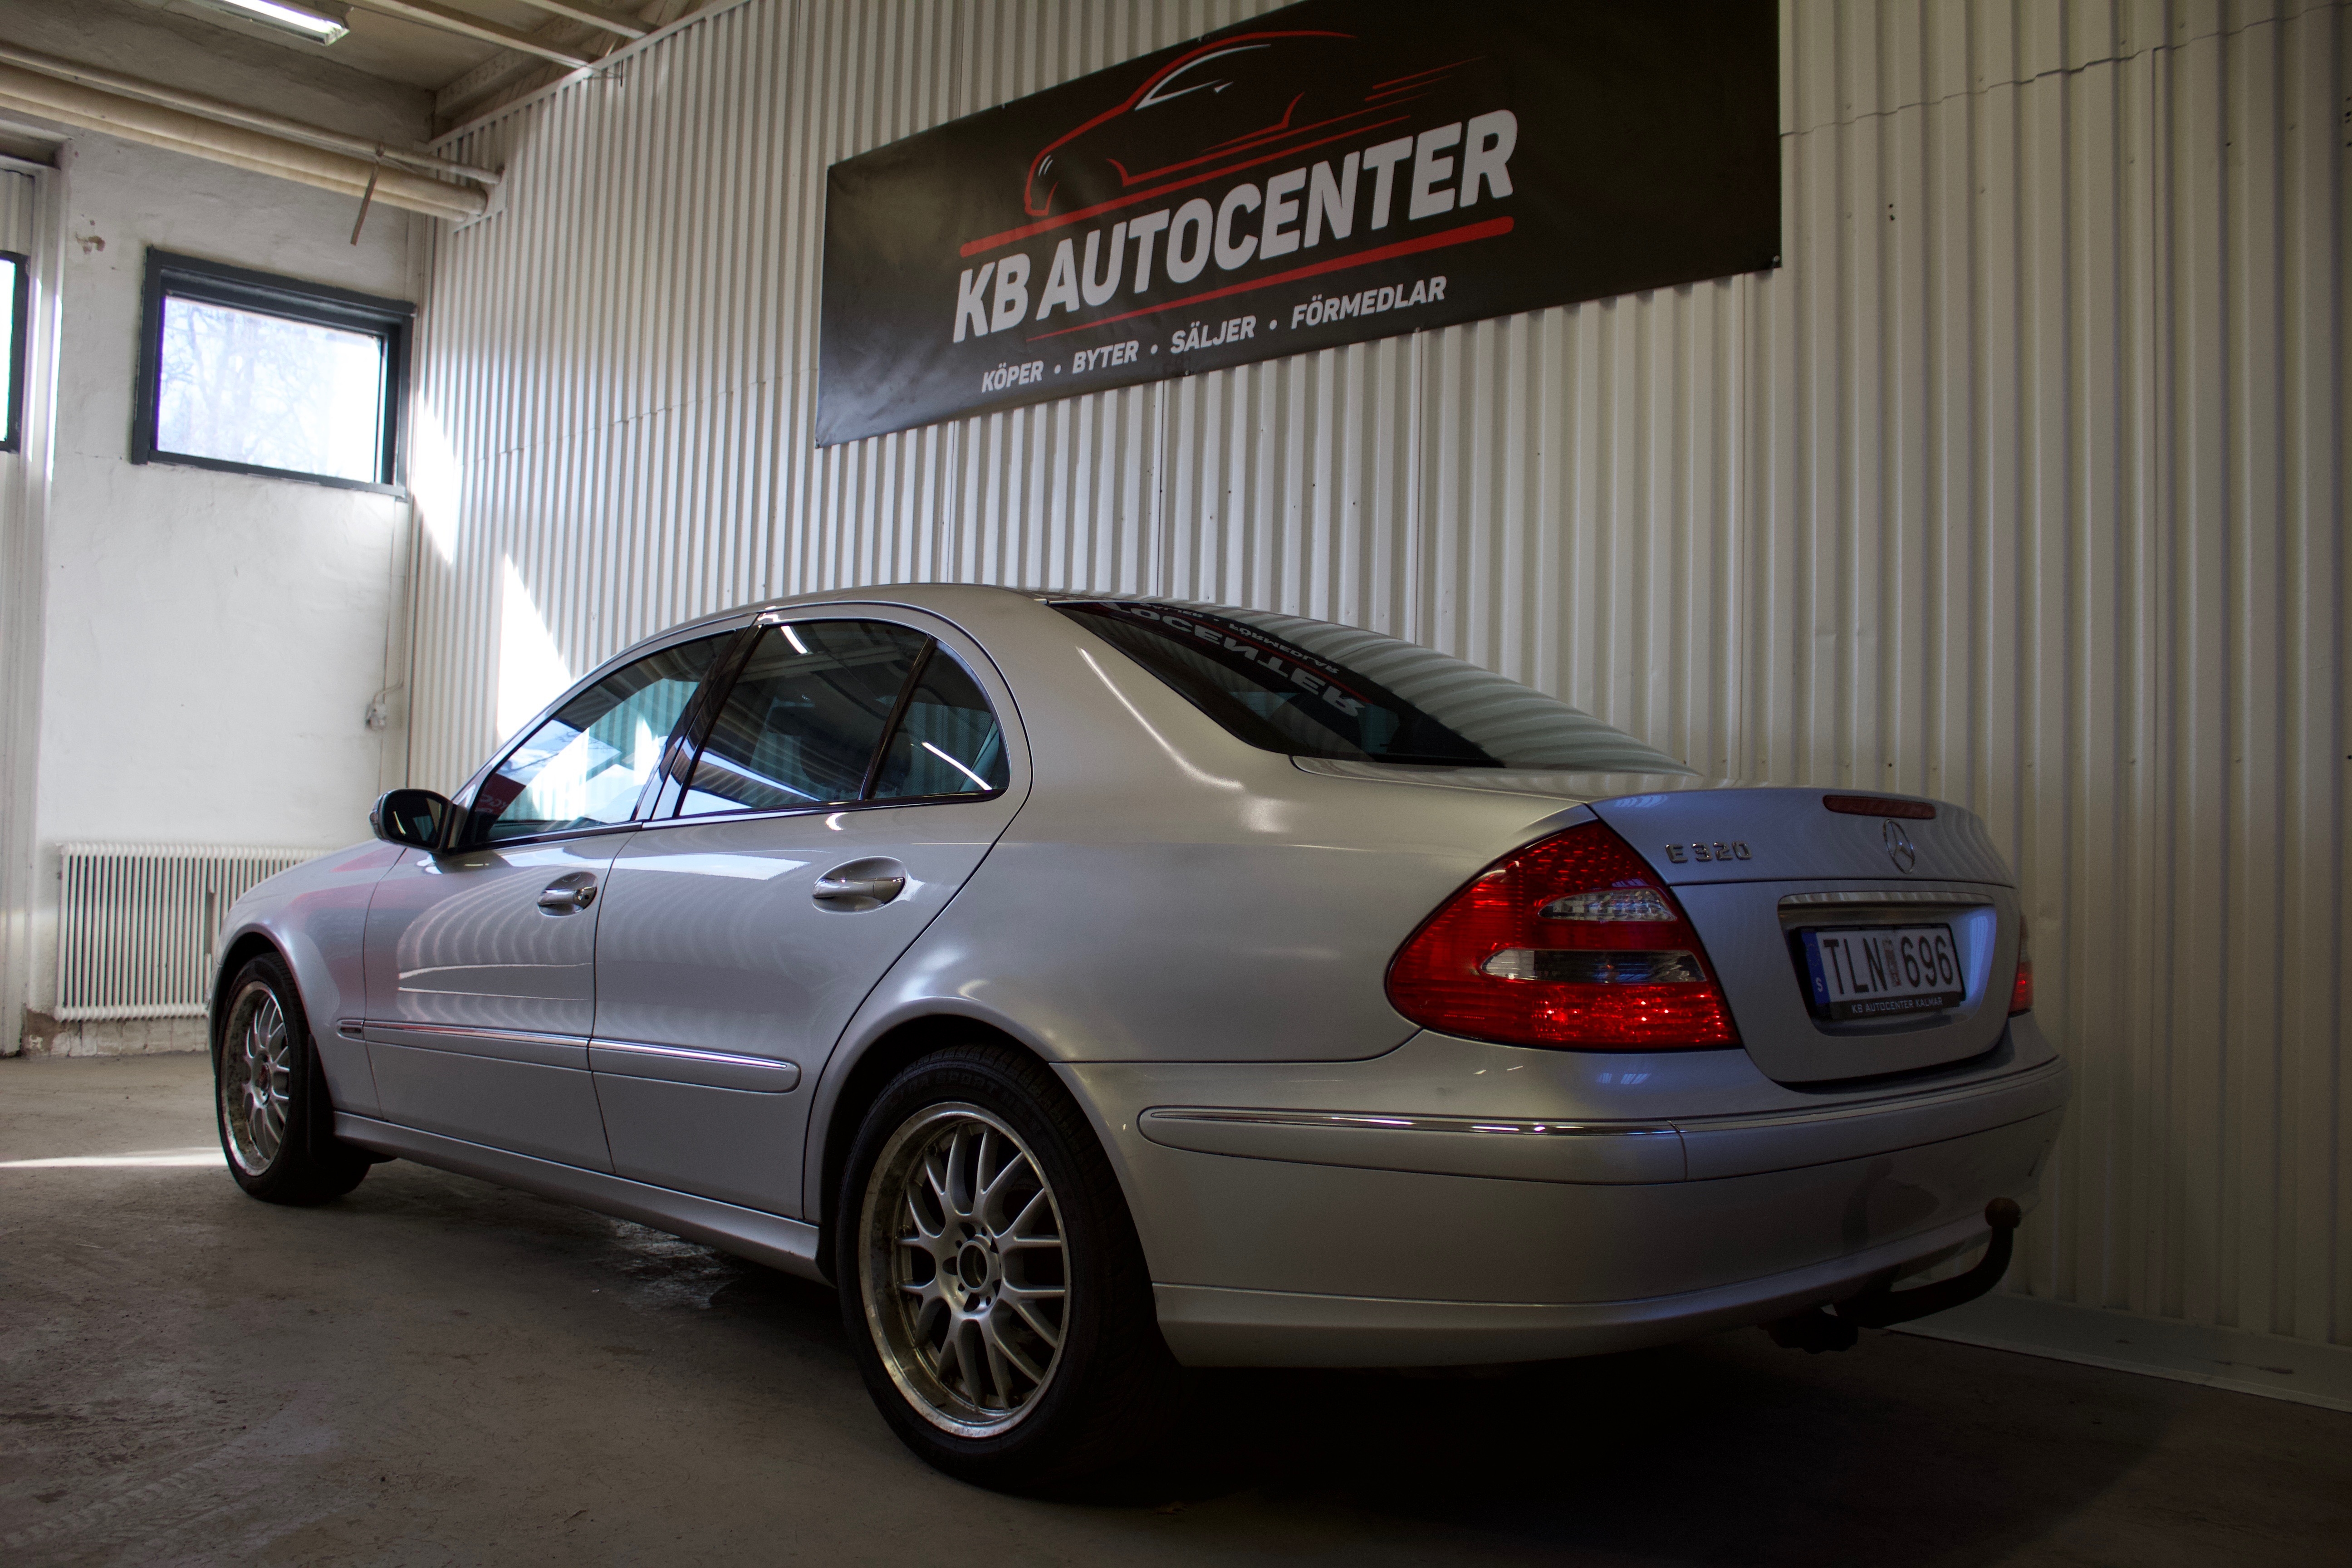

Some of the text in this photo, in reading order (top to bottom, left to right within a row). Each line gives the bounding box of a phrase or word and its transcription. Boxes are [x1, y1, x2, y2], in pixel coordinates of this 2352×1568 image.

[953, 110, 1517, 343] KB AUTOCENTER
[981, 276, 1447, 393] KÖPER BYTER SÄLJER FÖRMEDLAR
[1666, 841, 1753, 863] E 320
[1816, 977, 1823, 992] S
[1823, 937, 1888, 994] TLN
[1901, 936, 1953, 987] 696
[1852, 997, 1943, 1014] KB AUTOCENTER KALMAR
